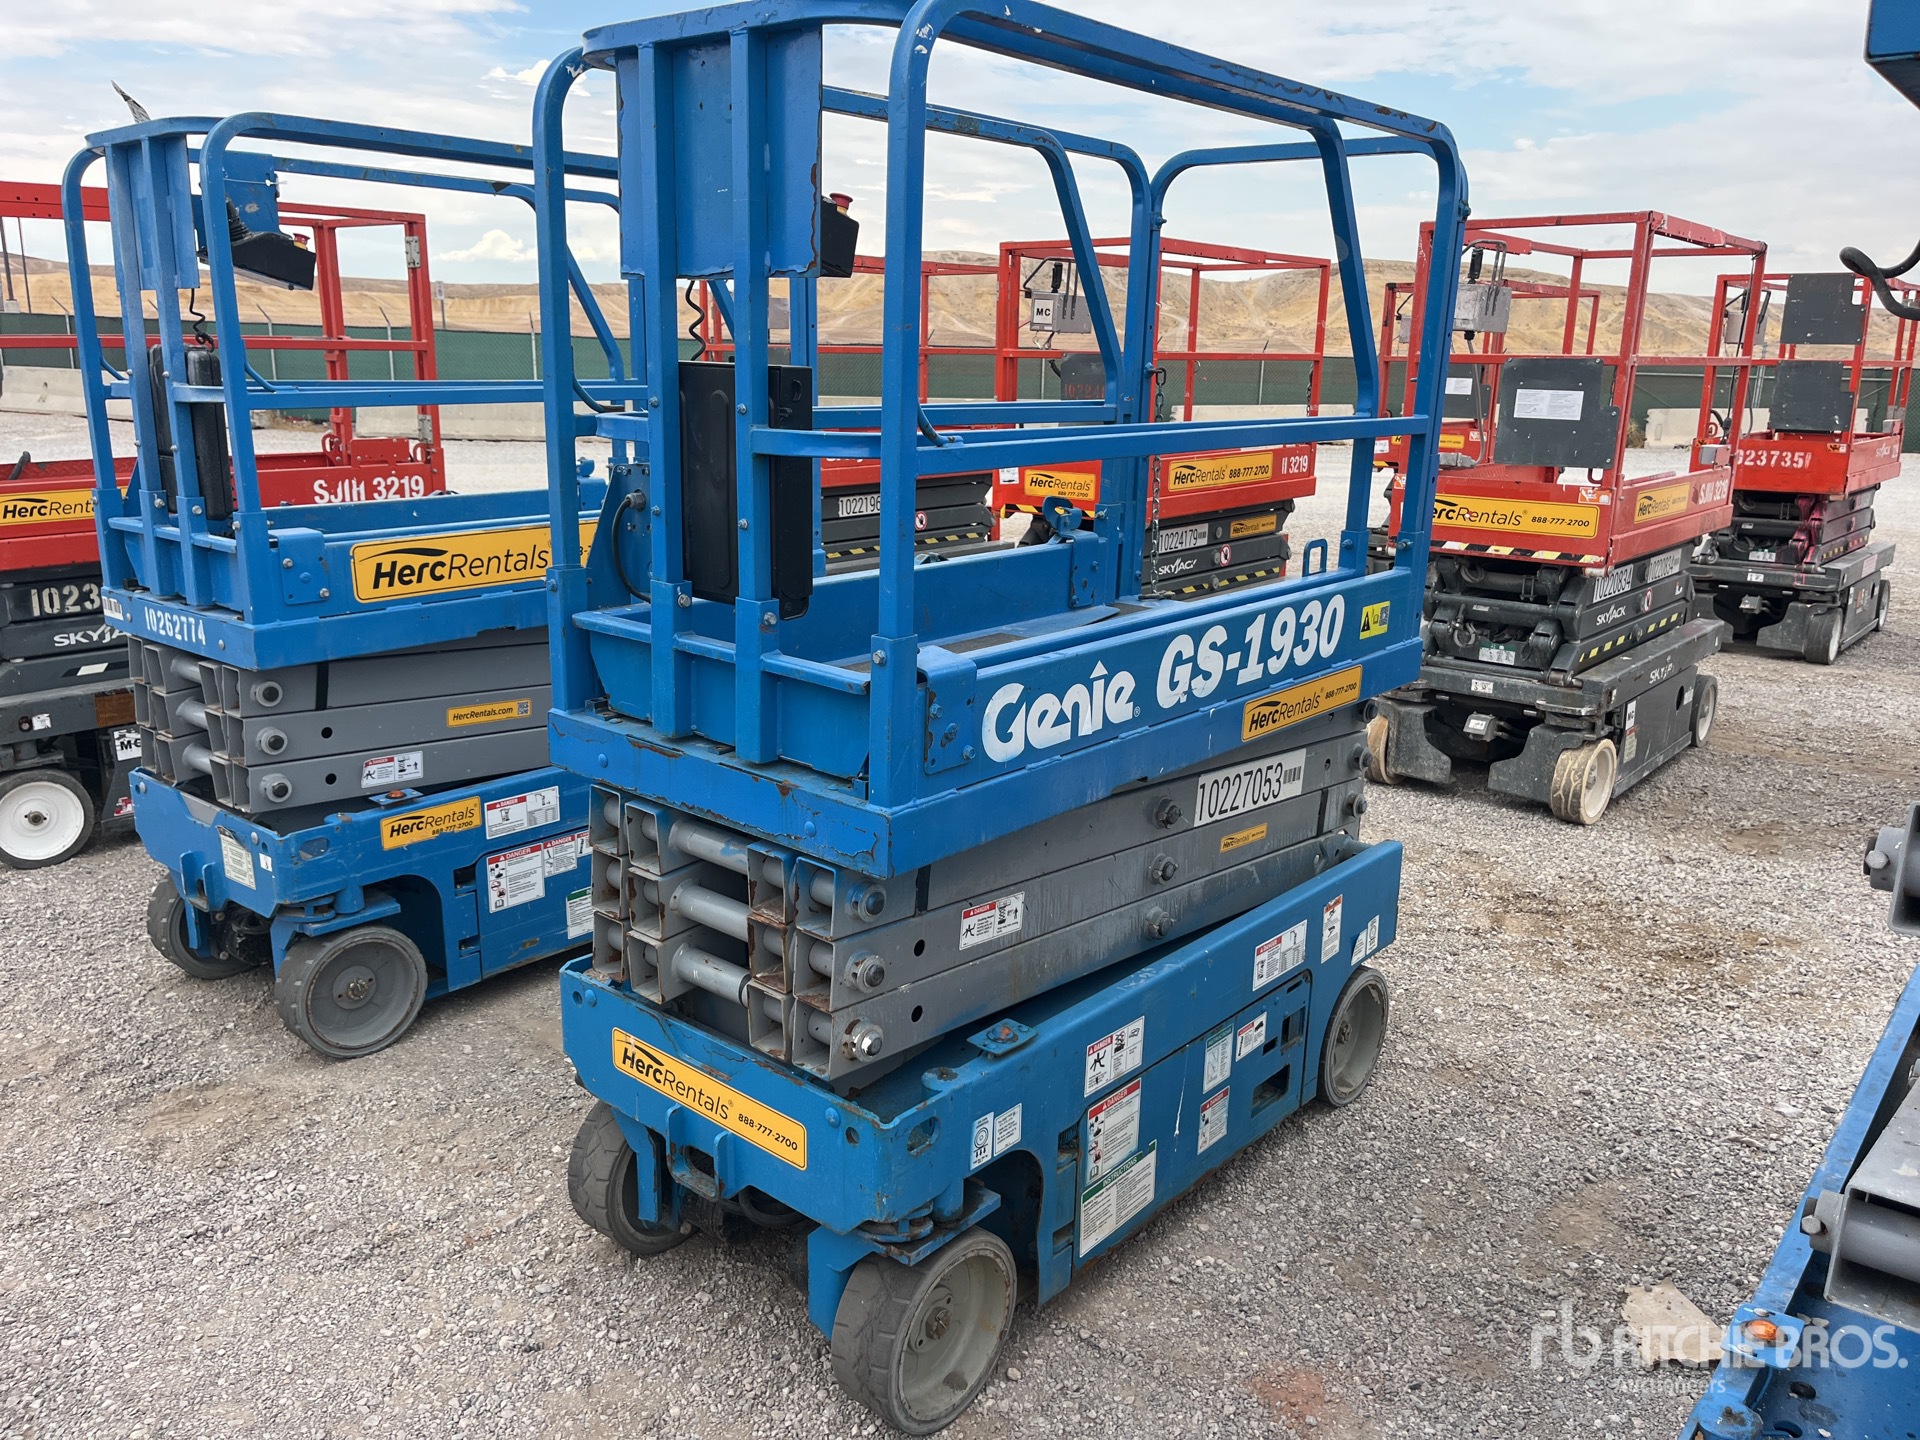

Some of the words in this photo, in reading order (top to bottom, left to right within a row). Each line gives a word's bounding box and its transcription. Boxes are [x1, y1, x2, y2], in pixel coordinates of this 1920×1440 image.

[1036, 308, 1051, 317] MC
[1173, 469, 1226, 485] HercRentals
[1228, 465, 1269, 479] 888-777-2700
[1289, 455, 1309, 474] 3219
[373, 475, 425, 500] 3219
[1030, 477, 1091, 491] HercRentals
[1432, 507, 1522, 527] ercRentals
[1531, 516, 1590, 528] 888-777-2700
[1159, 528, 1198, 553] 10224179
[371, 544, 549, 590] HercRentals
[144, 606, 206, 645] 10262774
[1596, 604, 1626, 626] SKYJACK
[982, 660, 1136, 762] Genie
[1156, 594, 1345, 709] GS-1930
[452, 706, 513, 722] HercRentals.com
[1249, 692, 1321, 733] HercRentals
[1324, 682, 1358, 700] 888-777-2700
[1199, 762, 1283, 822] 10227053
[389, 806, 475, 839] HercRentals
[551, 836, 572, 846] DANGER
[506, 848, 531, 860] DANGER
[1093, 1037, 1112, 1053] DANGER
[622, 1047, 729, 1120] HercRentals
[738, 1113, 798, 1151] 888-777-2700
[1106, 1088, 1128, 1107] DANGER
[1102, 1156, 1138, 1188] INSTRUCTIONS
